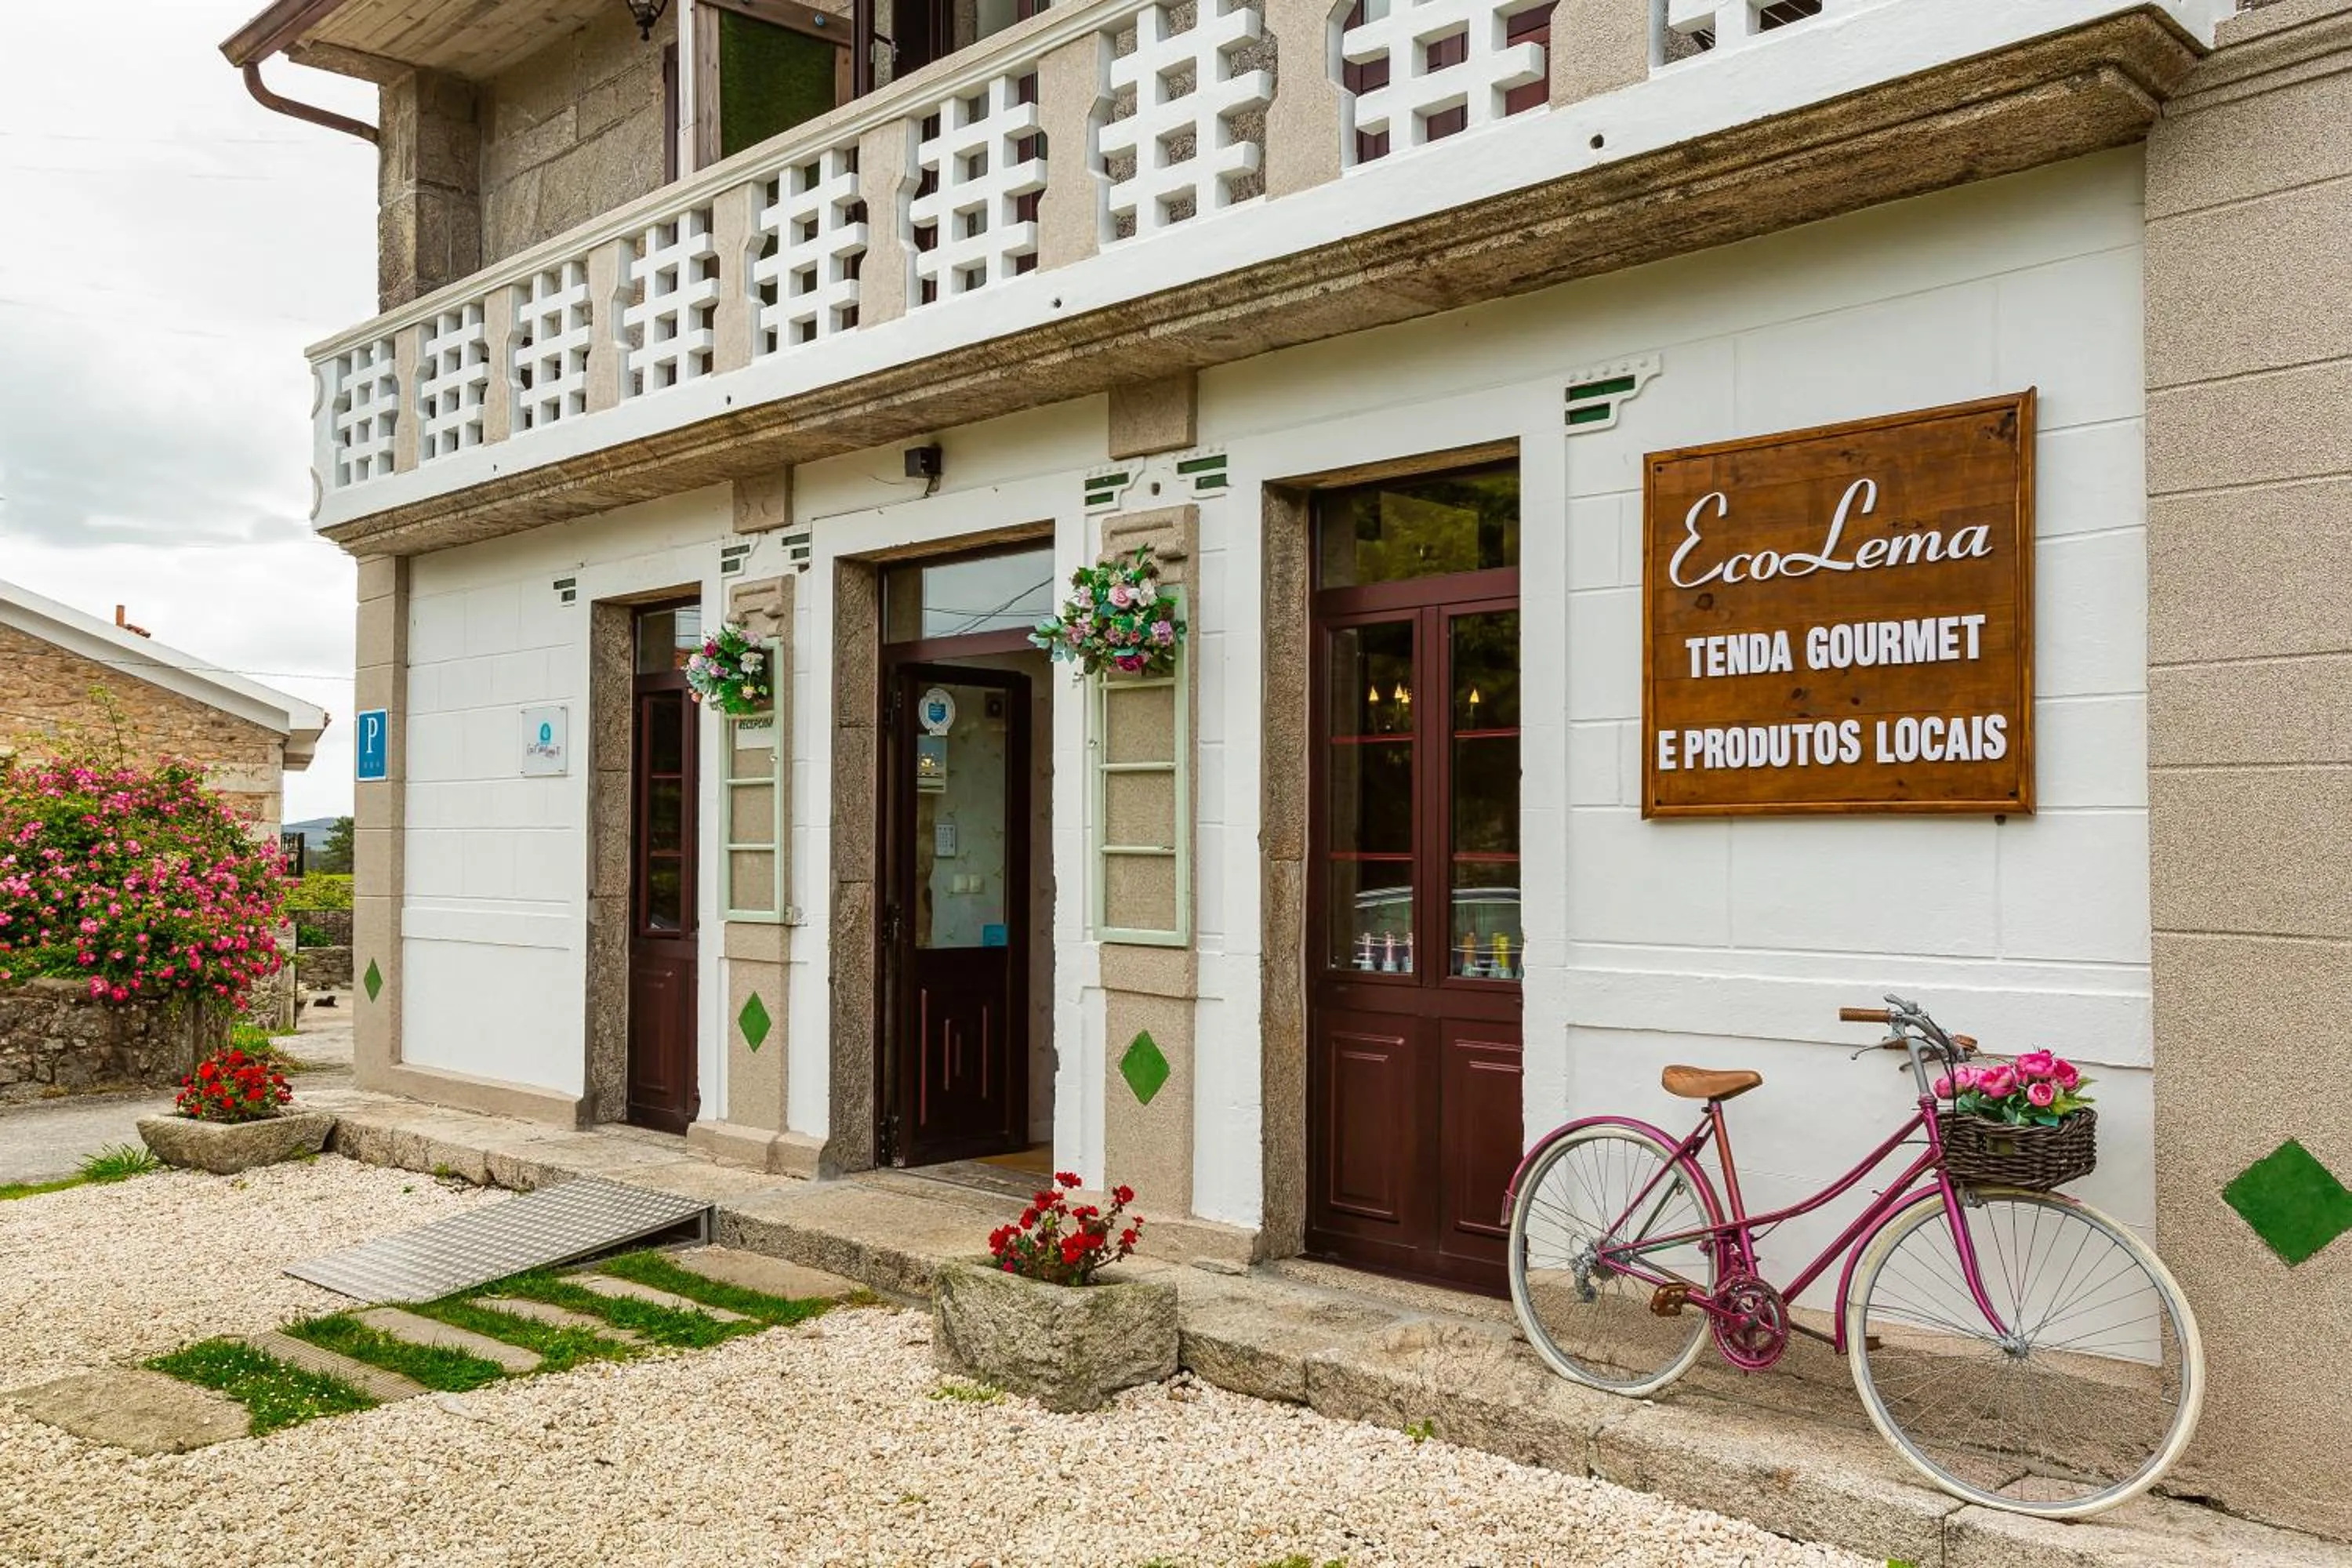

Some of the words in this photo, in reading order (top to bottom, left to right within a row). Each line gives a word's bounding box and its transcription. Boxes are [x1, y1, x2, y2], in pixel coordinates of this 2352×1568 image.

[1669, 478, 1993, 589] EcoLema
[1686, 630, 1793, 678] TENDA
[1806, 615, 1986, 671] GOURMET
[366, 717, 379, 753] P
[1658, 730, 1677, 771] E
[1684, 719, 1862, 770] PRODUTOS
[1876, 714, 2008, 764] LOCAIS
